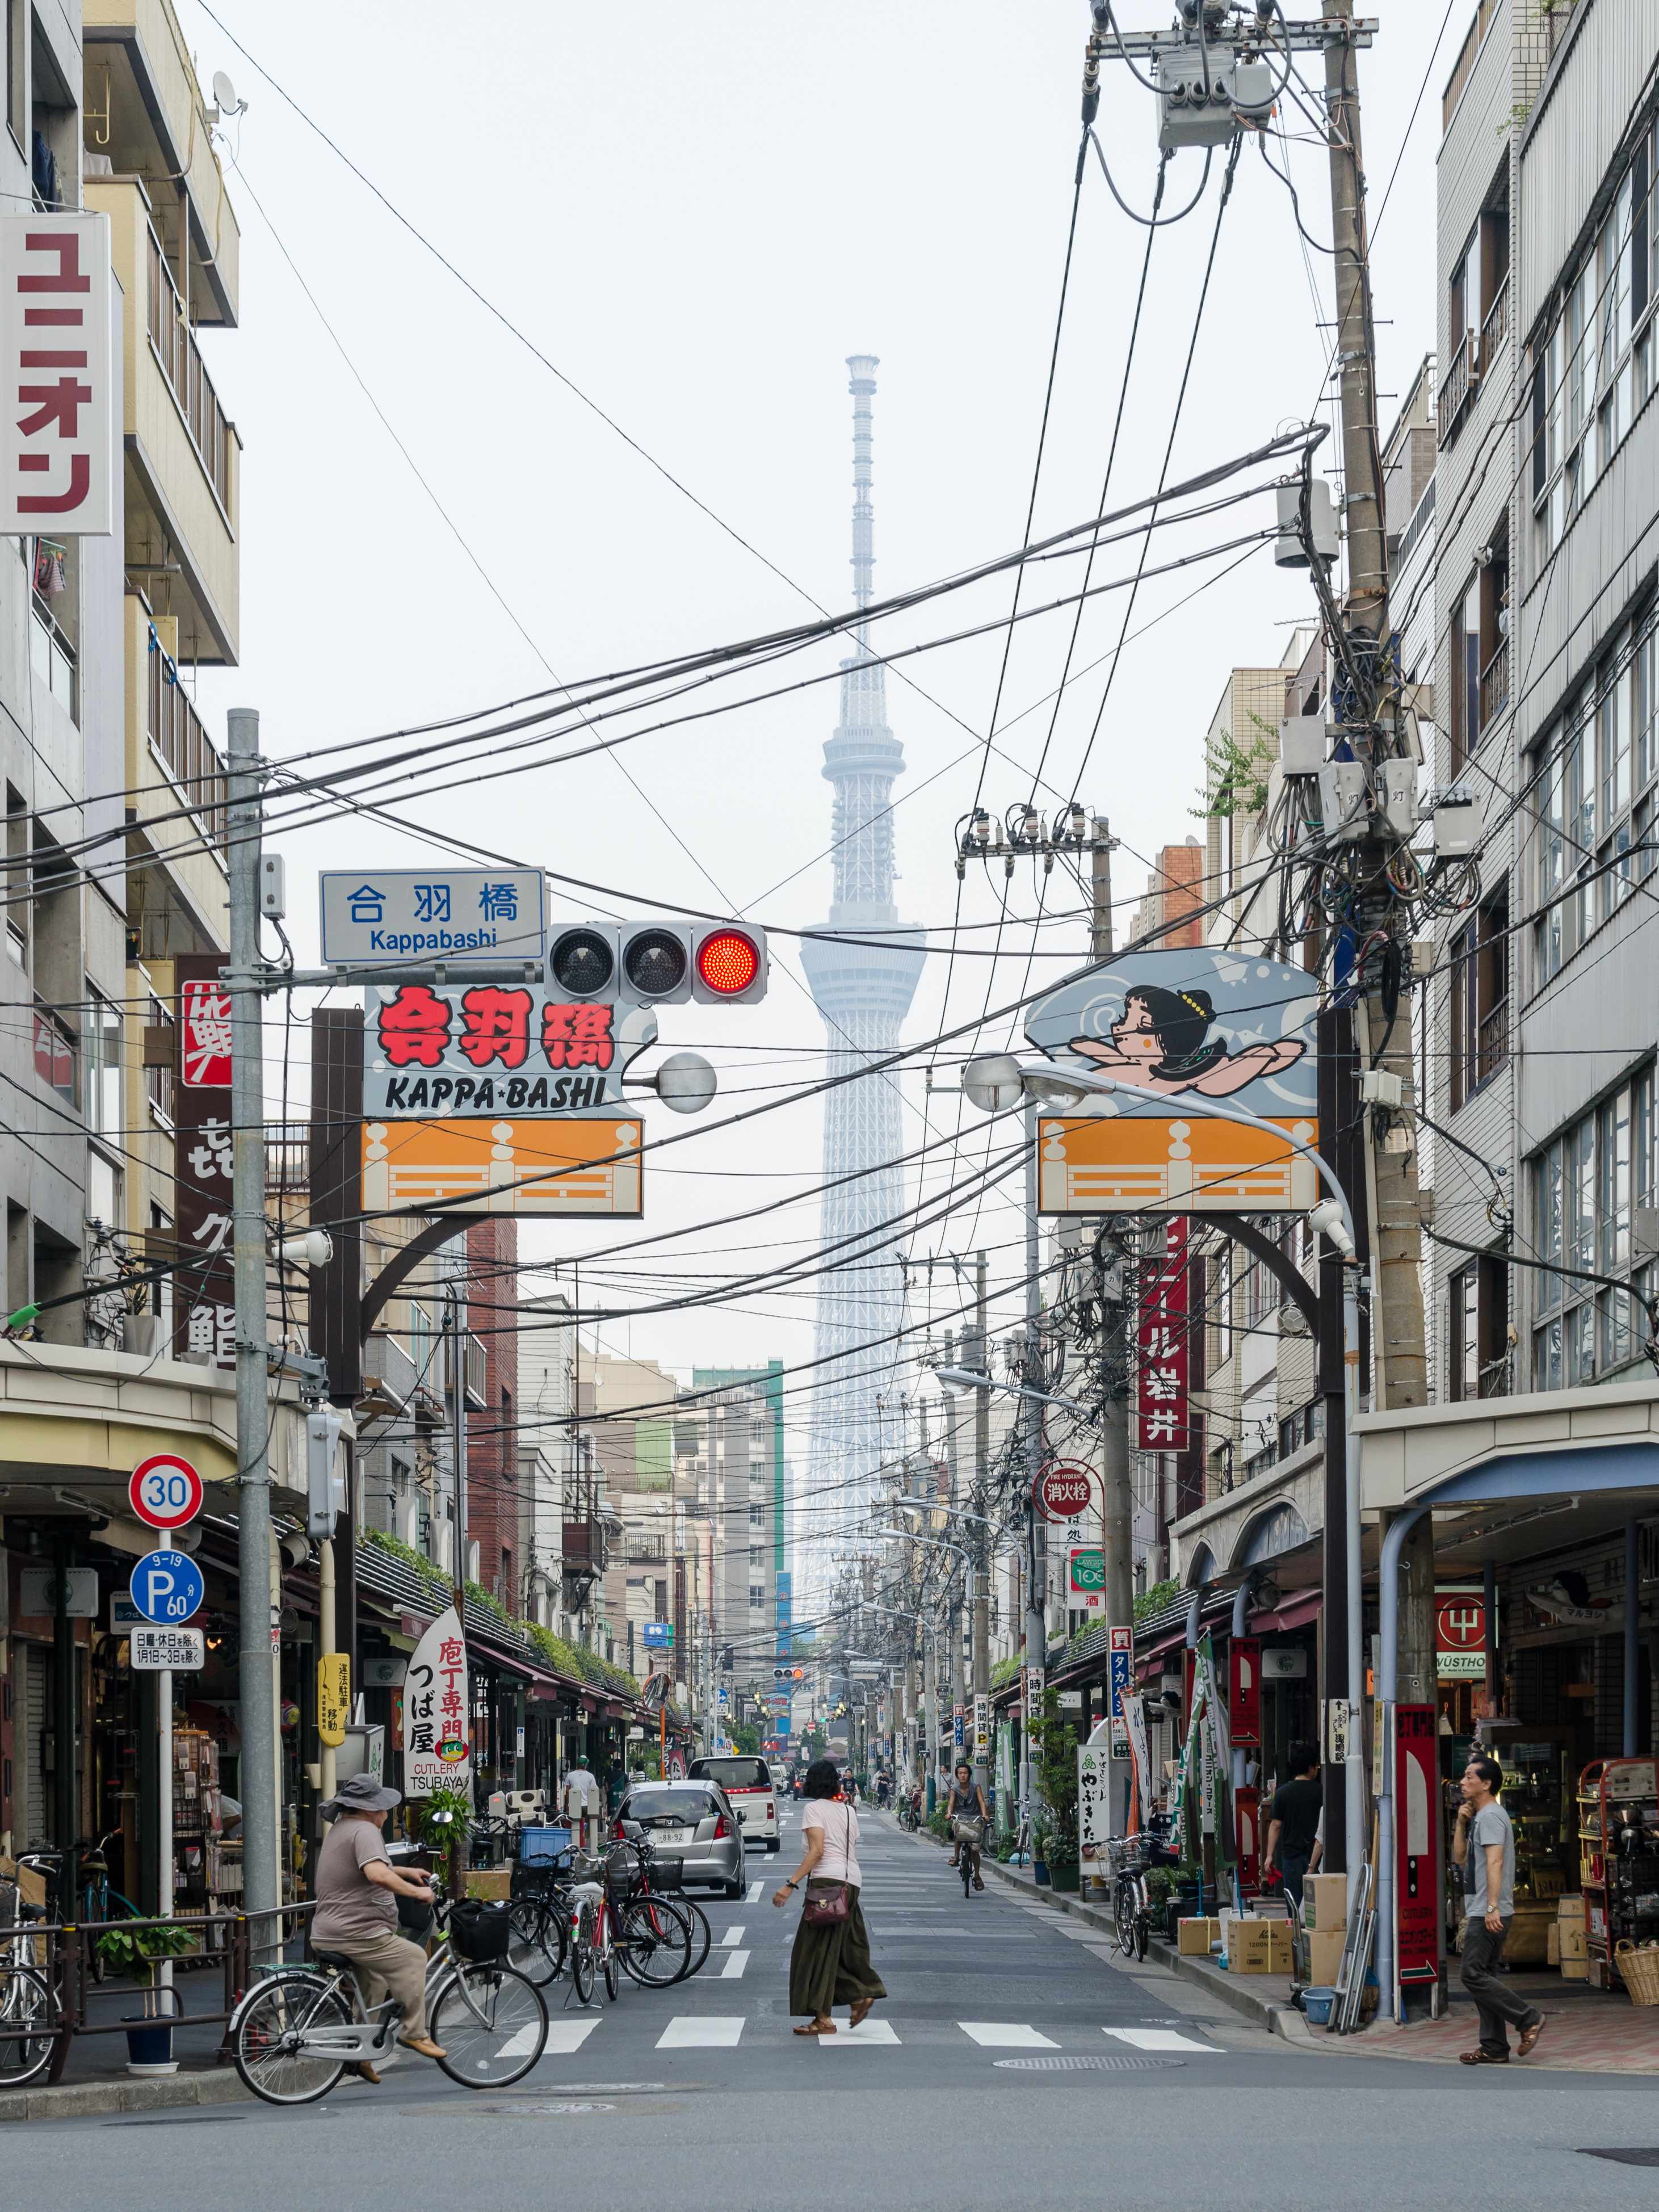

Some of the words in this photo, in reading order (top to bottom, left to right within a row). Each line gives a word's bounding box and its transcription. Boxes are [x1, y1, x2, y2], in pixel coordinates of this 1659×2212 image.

[16, 233, 92, 513] ユニオン
[347, 882, 519, 924] 合羽橋
[370, 928, 497, 954] Kappabashi
[377, 985, 616, 1070] 合羽橋
[148, 1475, 187, 1508] 30
[1047, 1481, 1088, 1502] 消火栓
[152, 1554, 183, 1568] 9-19
[148, 1570, 174, 1615] P
[187, 1583, 195, 1597] 分
[1085, 1595, 1099, 1606] 酒
[167, 1596, 187, 1616] 60
[1566, 1608, 1603, 1619] マルヨシ
[136, 1632, 198, 1647] 日曜・休日を除く
[1113, 1631, 1129, 1648] 質
[409, 1663, 435, 1754] つば屋
[977, 1702, 987, 1732] 時間貸
[414, 1763, 460, 1774] CUTLERY
[410, 1776, 464, 1790] TSUBAYA
[1081, 1772, 1098, 1841] やぶきた
